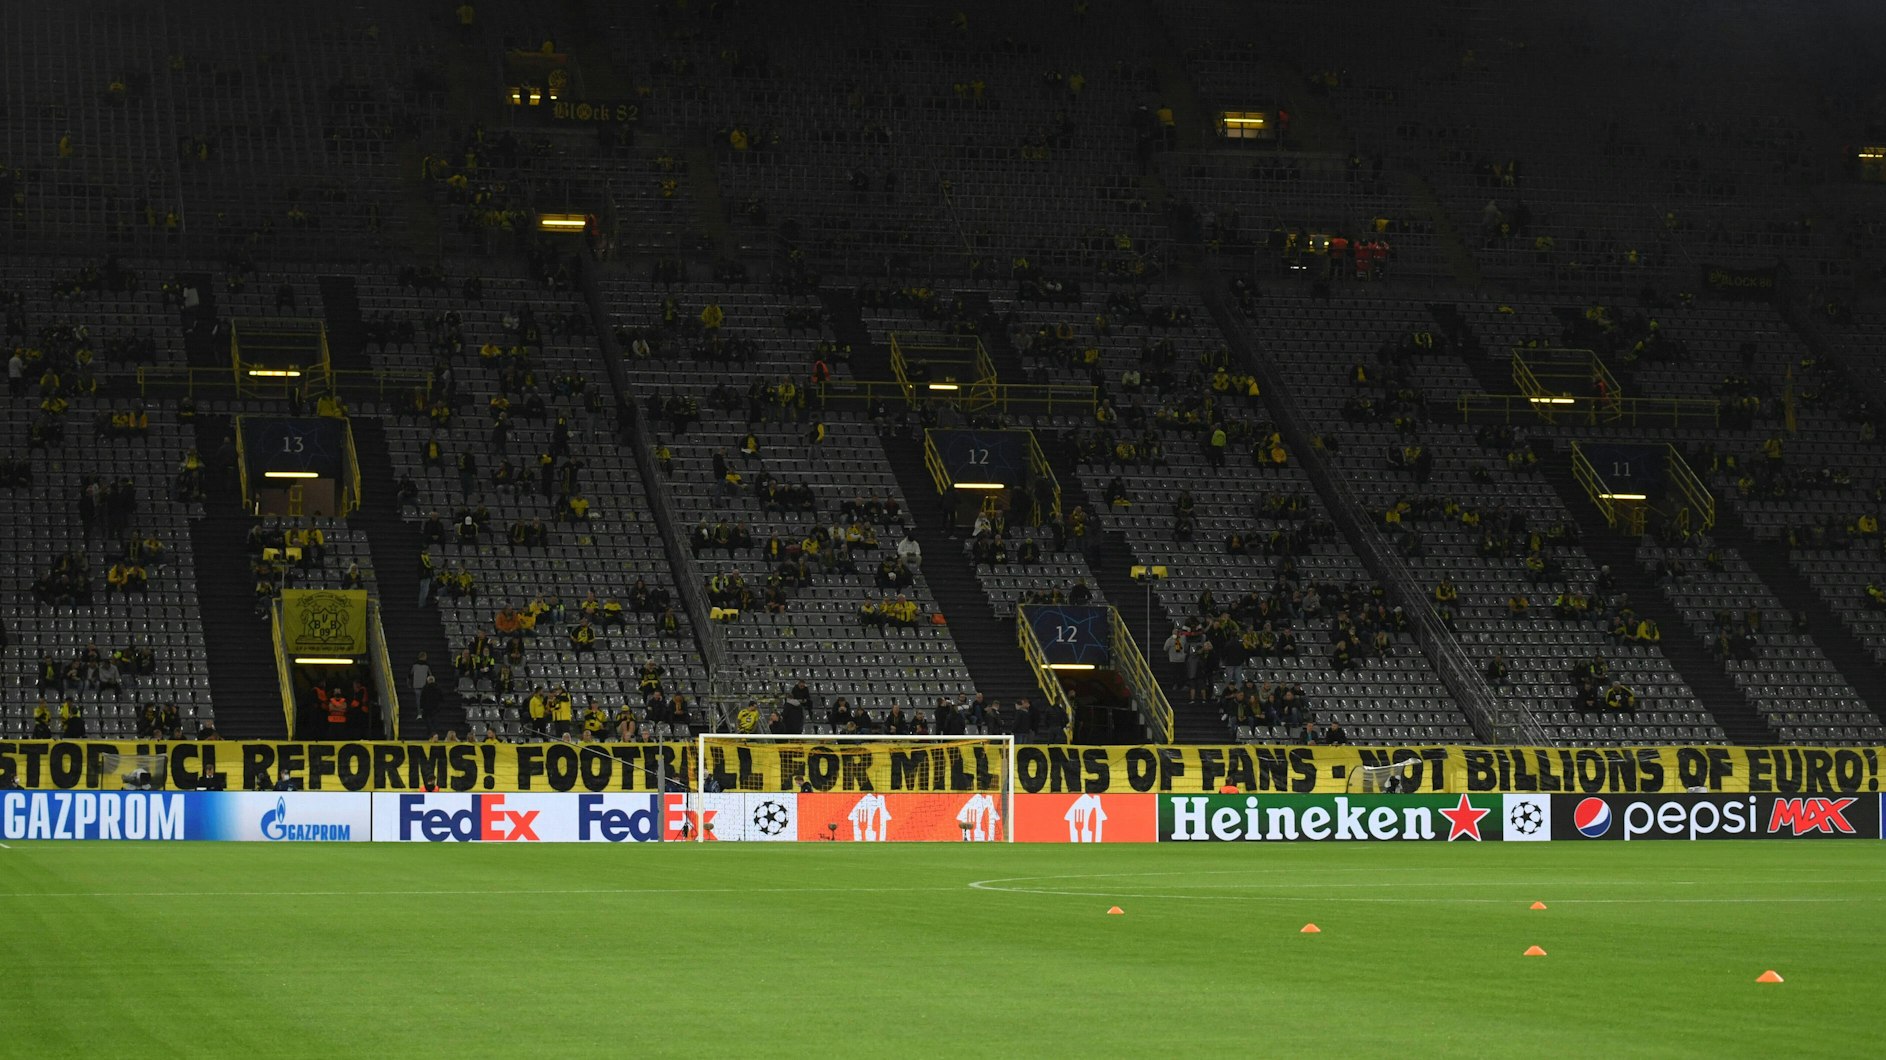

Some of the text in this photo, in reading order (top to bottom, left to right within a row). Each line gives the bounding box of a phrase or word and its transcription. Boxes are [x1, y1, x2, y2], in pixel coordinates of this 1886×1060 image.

[616, 104, 639, 121] 82
[282, 436, 305, 453] 13
[968, 448, 990, 465] 12
[1612, 461, 1632, 477] 11
[1055, 625, 1078, 643] 12
[0, 742, 120, 790] STOP
[242, 743, 496, 792] REFORMS!
[778, 746, 875, 792] FOR
[1125, 747, 1188, 794] OF
[1197, 747, 1318, 794] FANS
[1358, 748, 1449, 794] NOT
[1464, 748, 1666, 794] BILLIONS
[1676, 747, 1734, 791] OF
[1744, 748, 1880, 794] EURO!
[4, 792, 185, 840] GAZPROM
[399, 794, 541, 842] FedEx
[578, 794, 719, 842] FedEx
[1170, 796, 1436, 841] Heineken
[1623, 795, 1860, 840] pepsi MAX
[287, 824, 351, 841] GAZPROM
